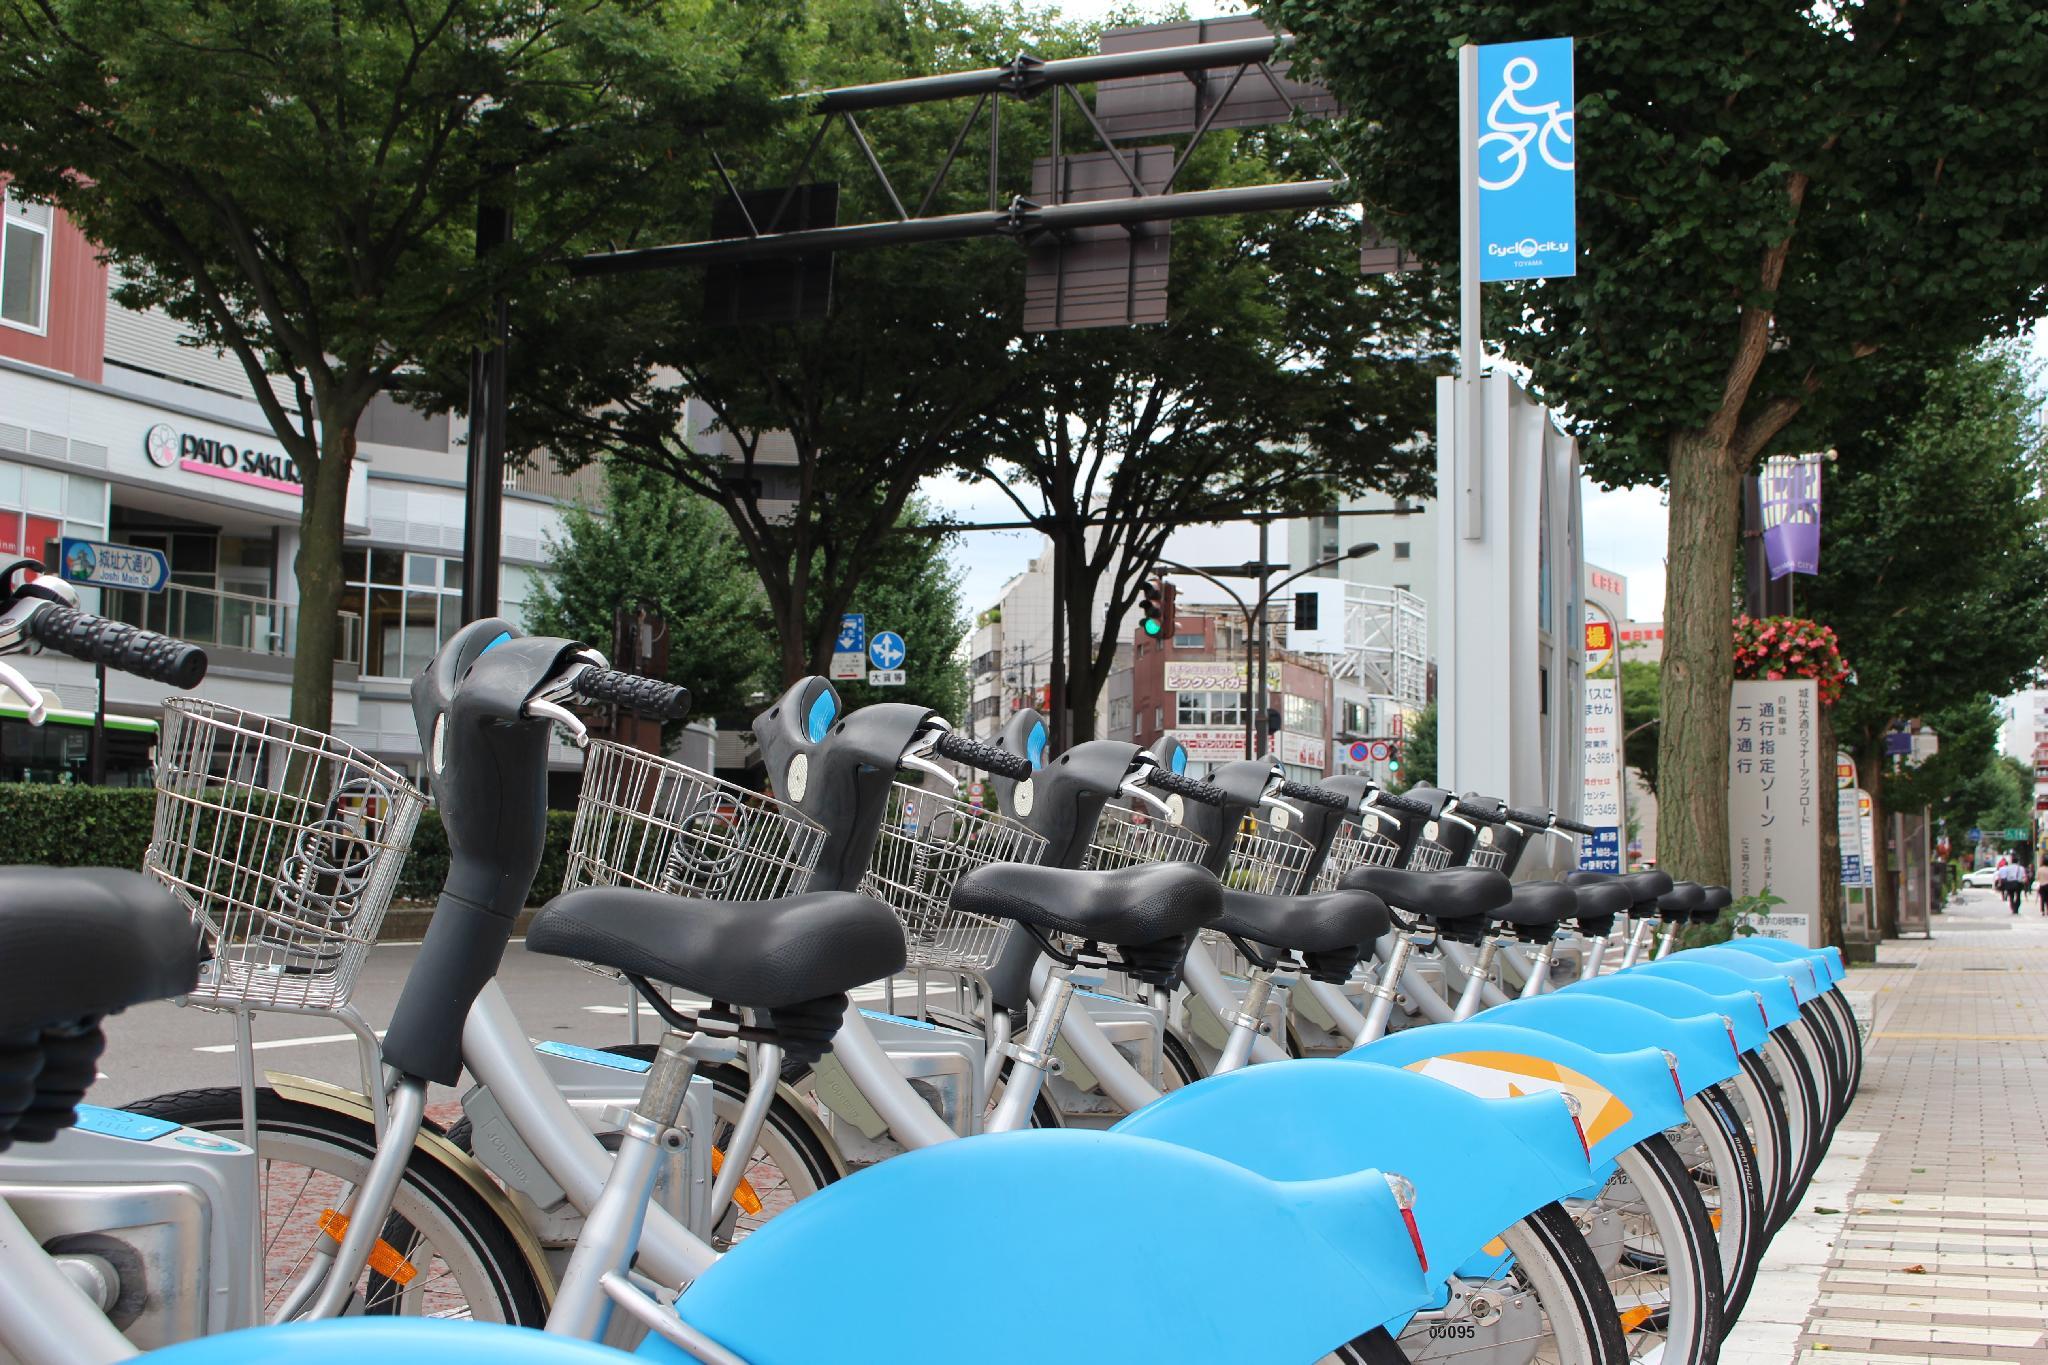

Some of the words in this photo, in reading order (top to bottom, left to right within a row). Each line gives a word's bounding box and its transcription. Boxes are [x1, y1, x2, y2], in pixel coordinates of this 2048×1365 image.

[1514, 260, 1543, 268] TOYAMA
[181, 433, 238, 468] PATIO
[241, 449, 303, 484] SAKUR
[99, 550, 153, 573] 城址大通り
[100, 570, 120, 582] Joshi
[122, 572, 139, 584] Main
[1585, 625, 1607, 649] 場
[1736, 705, 1752, 775] 一方通行
[1428, 1325, 1476, 1339] 00095
